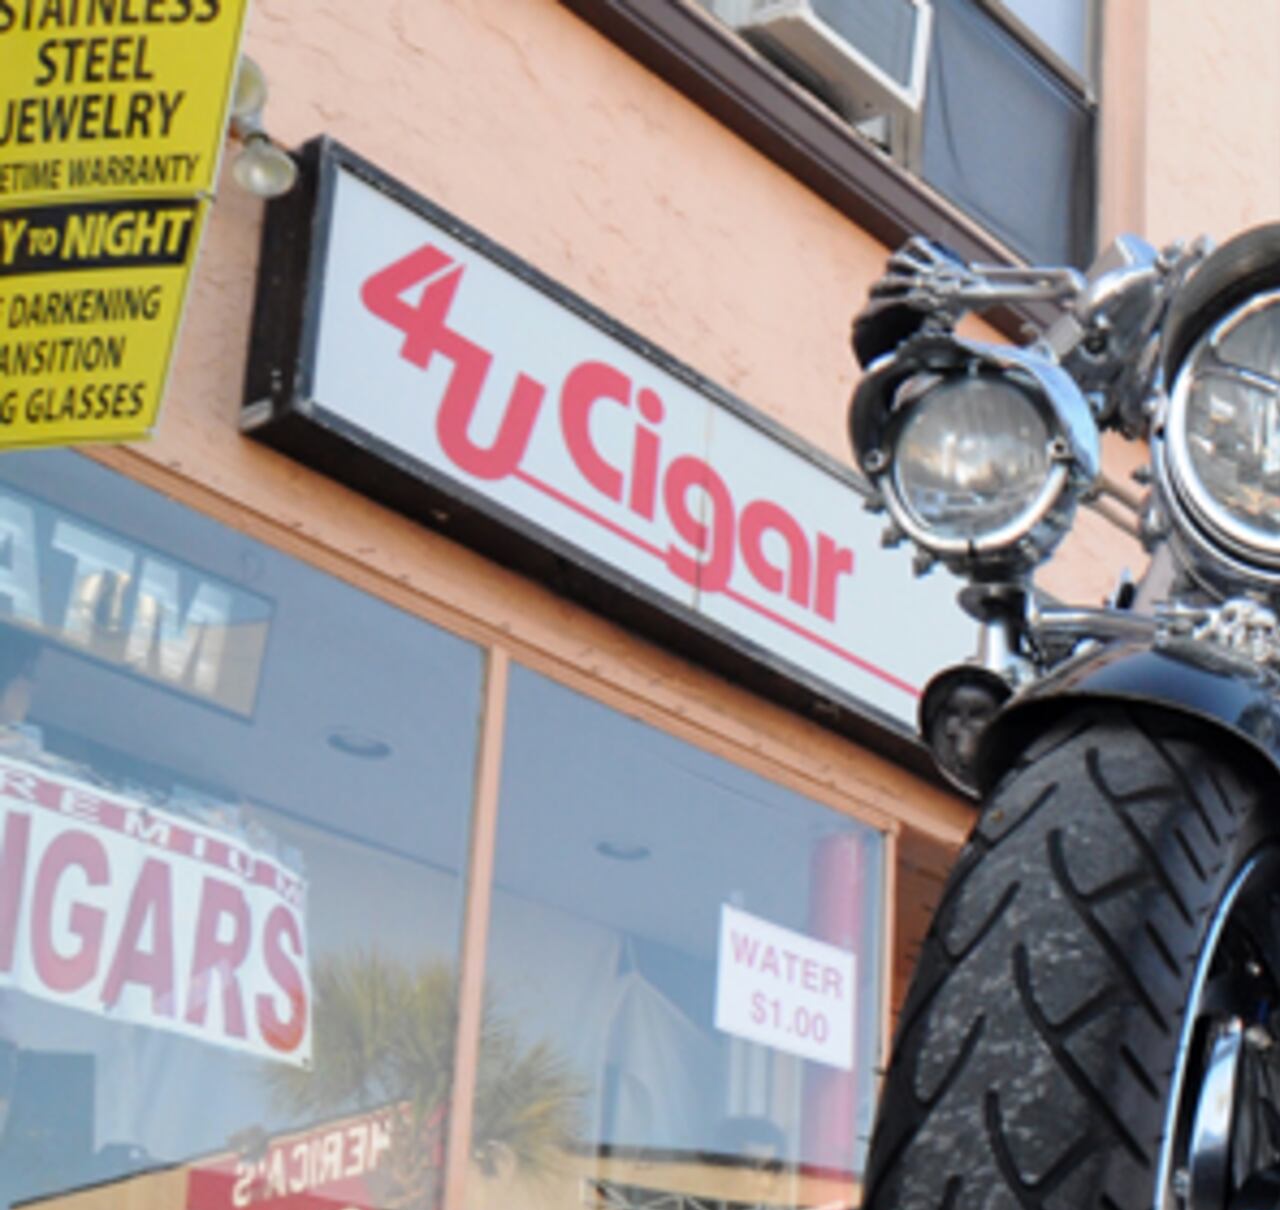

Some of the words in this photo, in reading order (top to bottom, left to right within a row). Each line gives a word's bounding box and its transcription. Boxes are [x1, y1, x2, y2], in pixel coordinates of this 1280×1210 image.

[34, 35, 155, 87] STEEL
[0, 91, 186, 147] JEWELRY
[67, 153, 200, 189] WARRANTY
[28, 226, 59, 256] TO
[60, 209, 194, 260] NIGHT
[8, 285, 163, 329] DARKENING
[25, 381, 147, 424] GLASSES
[559, 359, 855, 624] Cigar
[0, 500, 232, 697] ATM
[729, 929, 844, 1000] WATER
[751, 990, 829, 1045] $1.00
